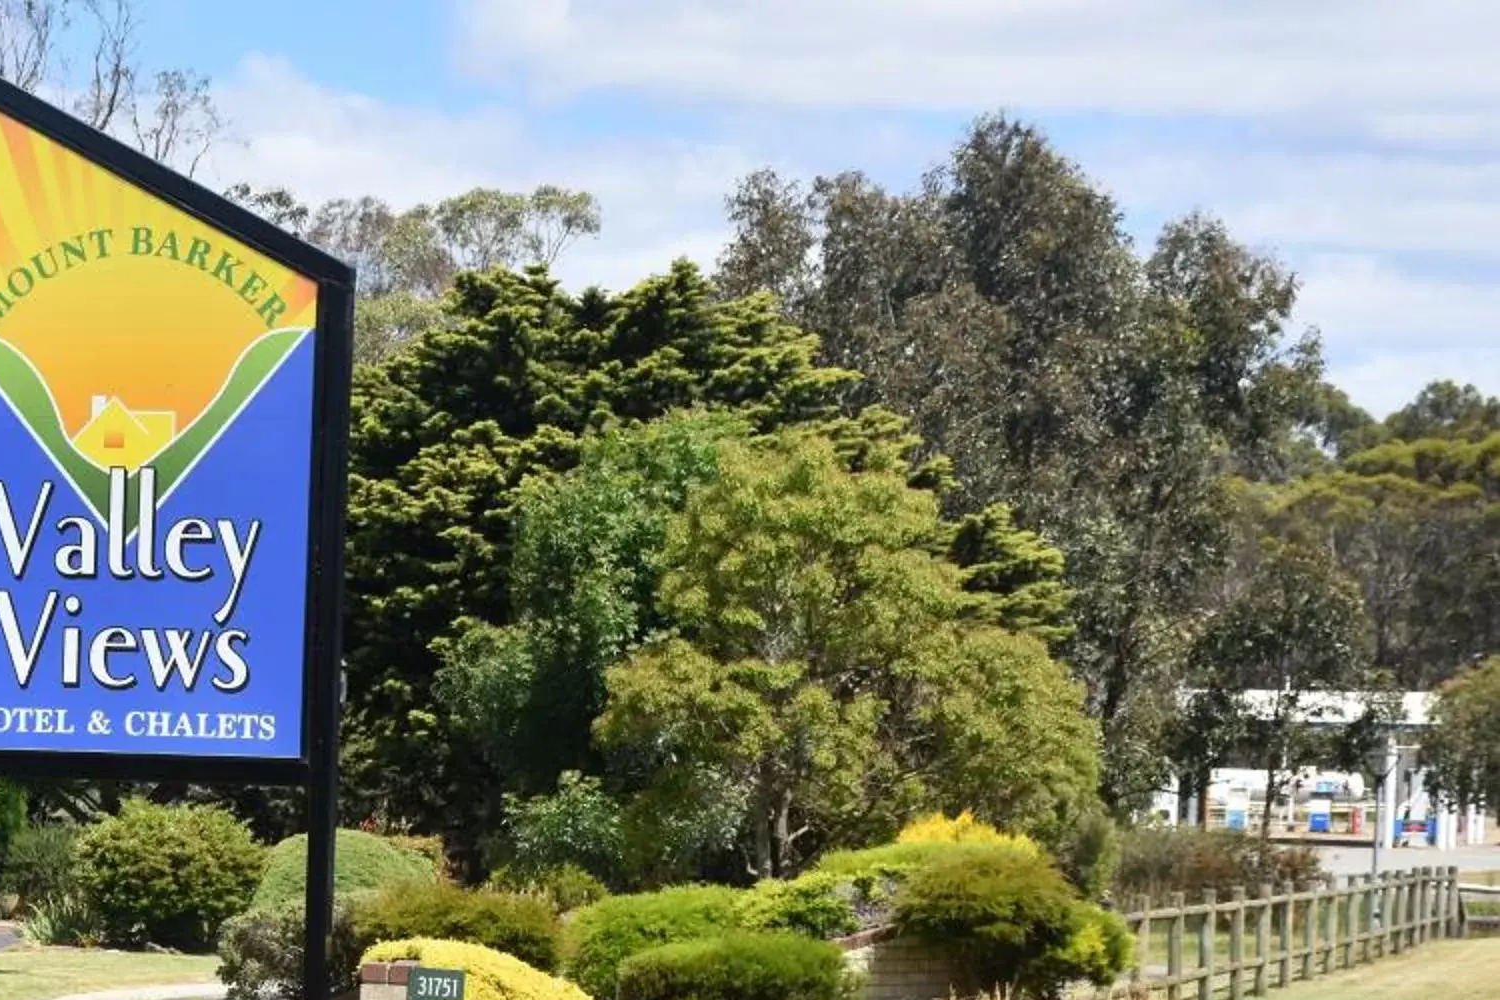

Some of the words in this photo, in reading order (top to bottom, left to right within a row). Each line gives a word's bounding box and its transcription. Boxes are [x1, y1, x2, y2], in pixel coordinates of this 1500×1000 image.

[130, 226, 287, 328] BARKER
[87, 709, 112, 736] &
[125, 711, 277, 740] CHALETS
[417, 975, 458, 998] 31751
